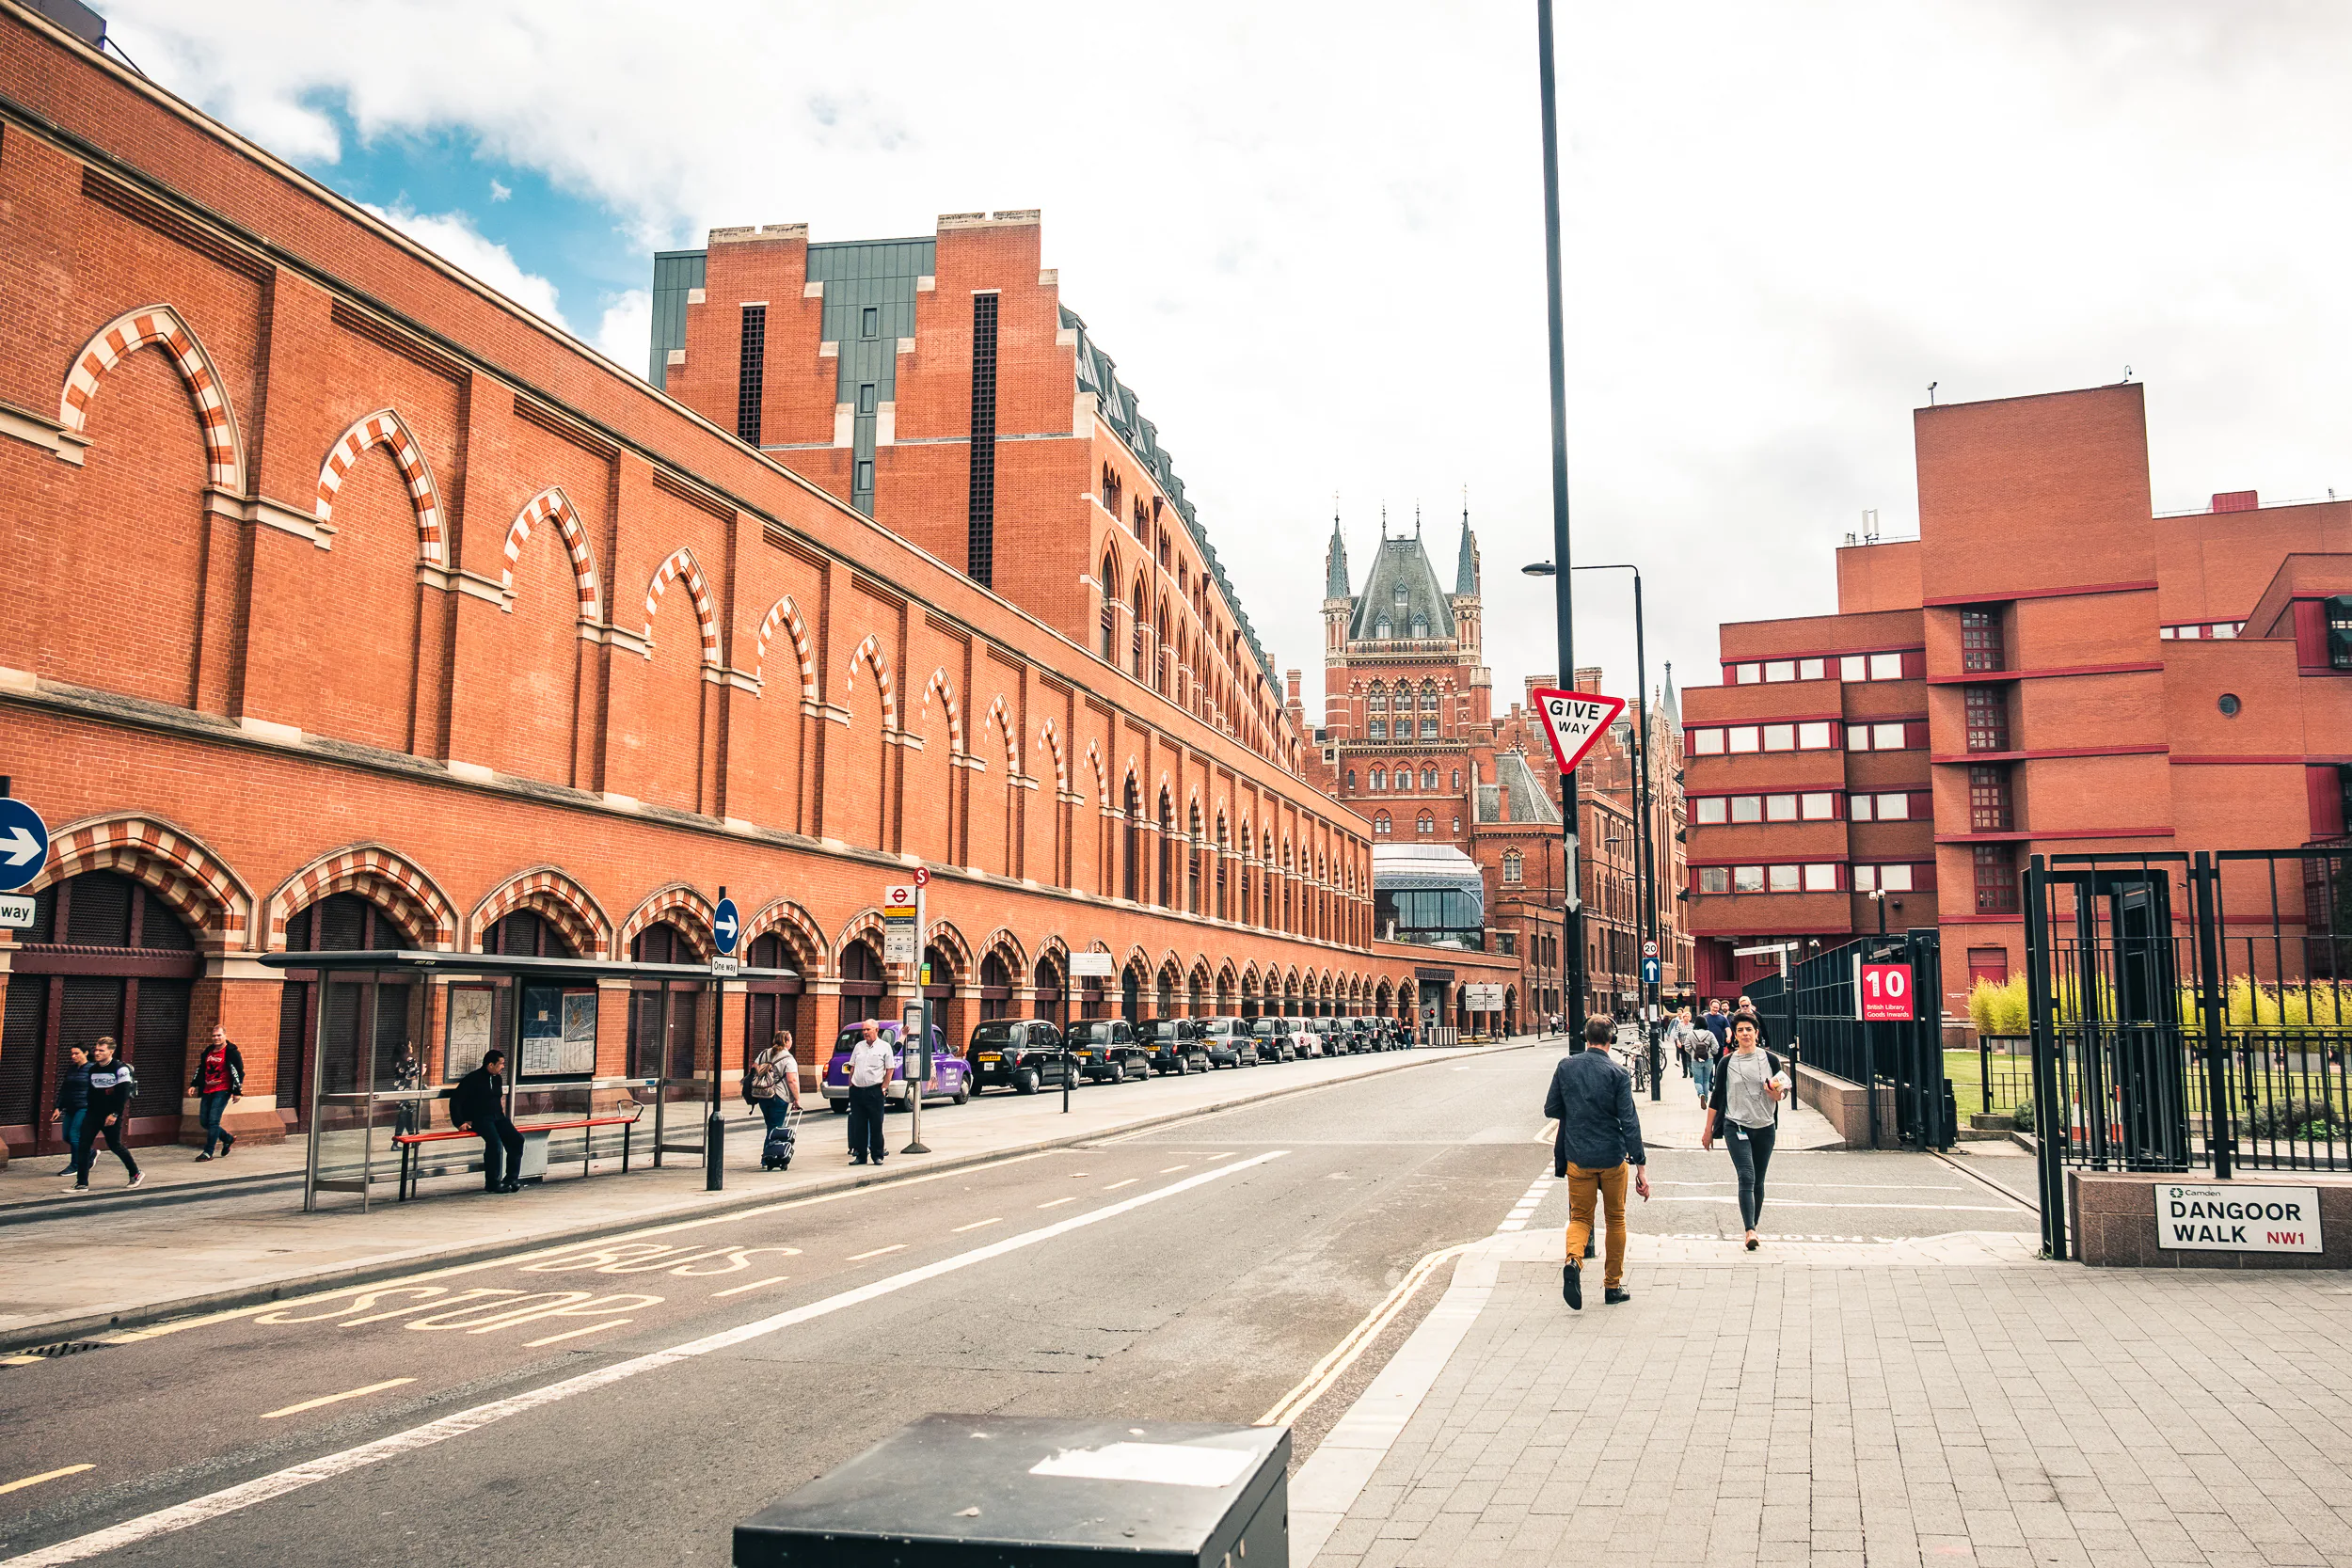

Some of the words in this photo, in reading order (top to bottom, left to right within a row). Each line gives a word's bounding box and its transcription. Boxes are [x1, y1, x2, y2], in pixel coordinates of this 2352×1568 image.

[1549, 700, 1600, 721] GIVE
[1558, 721, 1590, 735] WAY
[916, 869, 926, 884] S
[1, 906, 30, 922] way
[1645, 944, 1657, 953] 20
[714, 960, 724, 971] One
[726, 964, 737, 973] way
[1866, 971, 1905, 997] 10
[2185, 1189, 2221, 1197] Camden
[2170, 1201, 2302, 1221] DANGOOR
[2173, 1225, 2248, 1243] WALK
[2267, 1231, 2305, 1244] NW1
[518, 1243, 804, 1277] BUS
[254, 1286, 666, 1334] STOP
